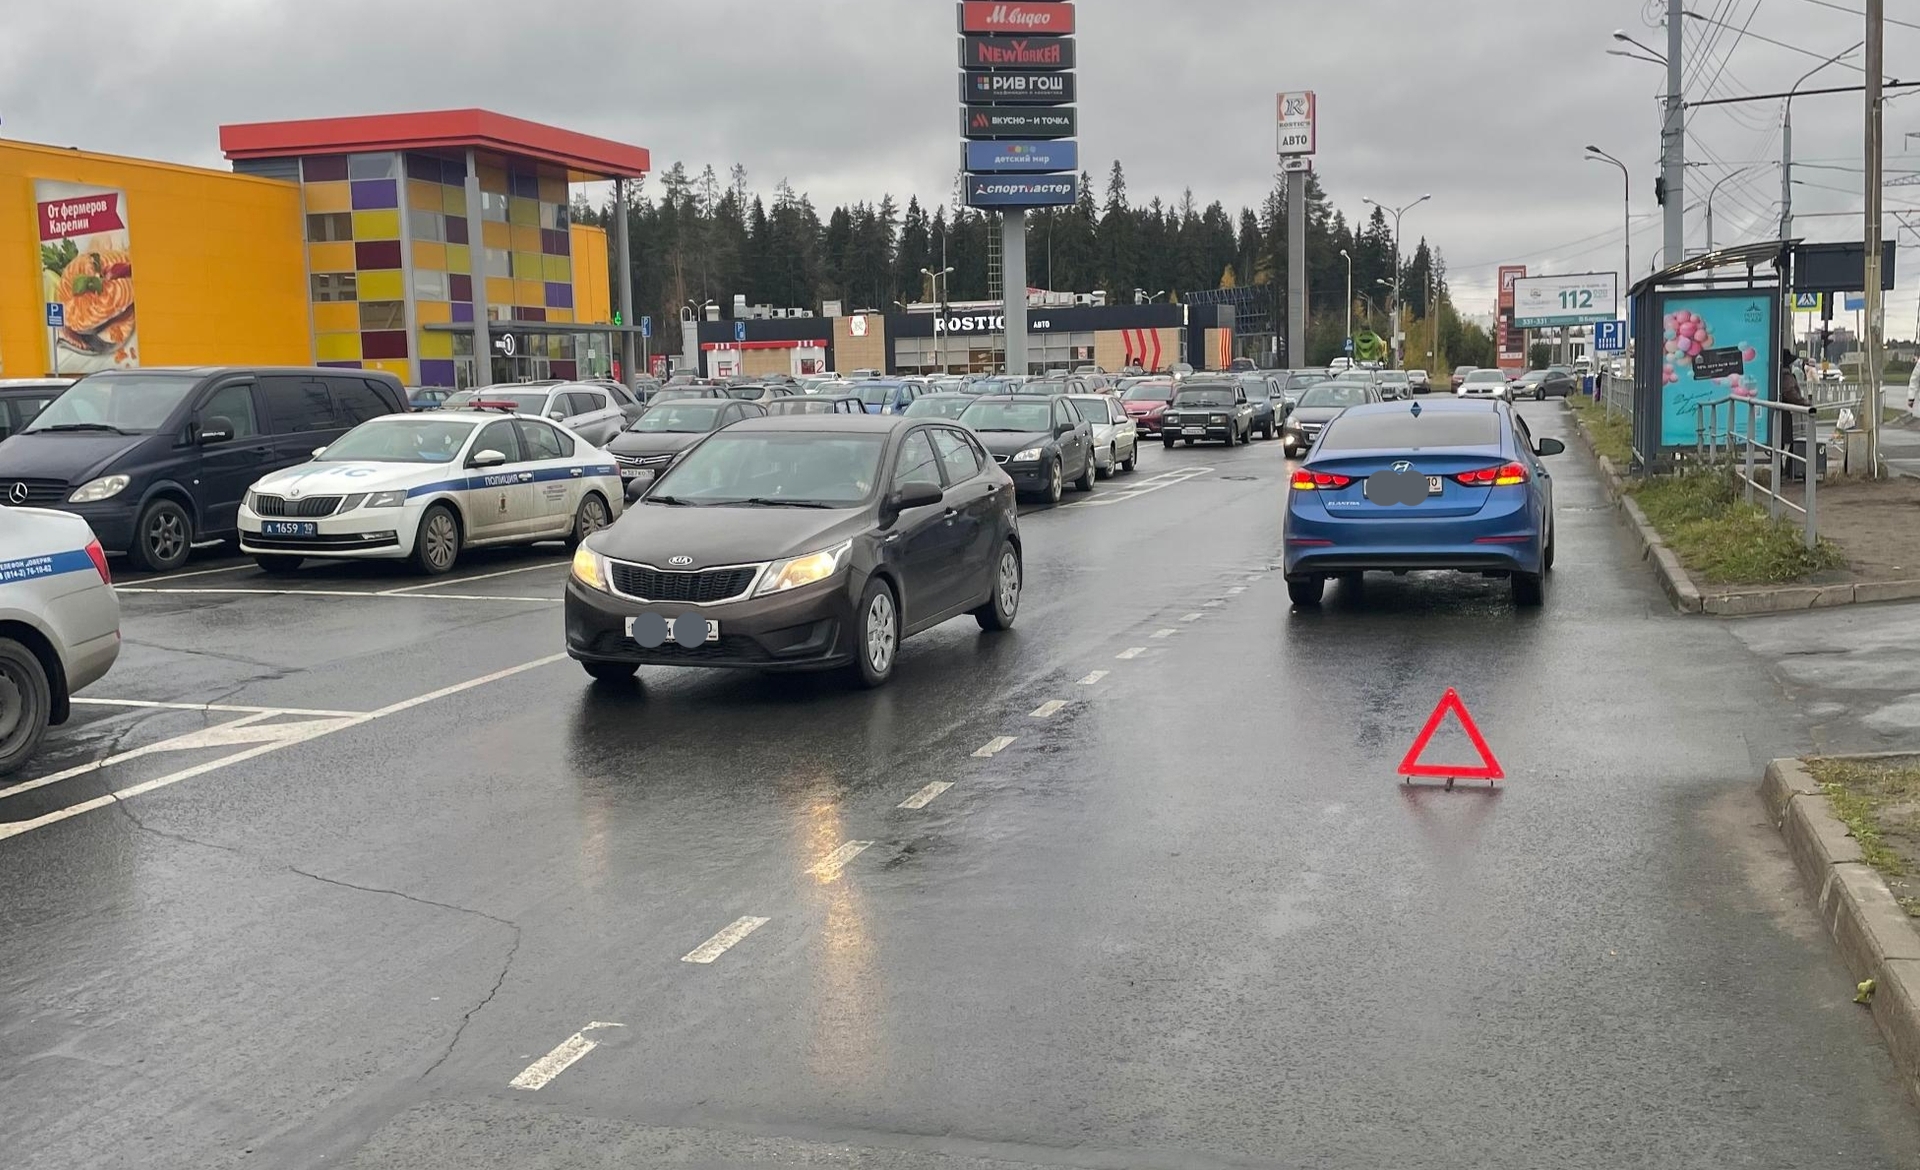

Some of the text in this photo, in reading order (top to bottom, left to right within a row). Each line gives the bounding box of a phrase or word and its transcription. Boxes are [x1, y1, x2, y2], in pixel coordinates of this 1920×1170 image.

[986, 5, 1050, 28] М.видео
[993, 76, 1063, 90] РИВ ГОШ
[1042, 116, 1070, 124] ТОЧКА
[1282, 135, 1307, 146] АВТО
[994, 155, 1050, 164] детский мир
[986, 184, 1070, 195] спортмастер
[48, 198, 108, 220] От фермеров
[50, 217, 89, 235] Карелии
[1558, 290, 1592, 309] 112
[1034, 320, 1050, 329] АВТО
[816, 360, 824, 373] 2
[484, 474, 519, 486] ПОЛИЦИЯ
[267, 525, 272, 533] А
[276, 523, 298, 533] 1659
[672, 556, 689, 564] KIA
